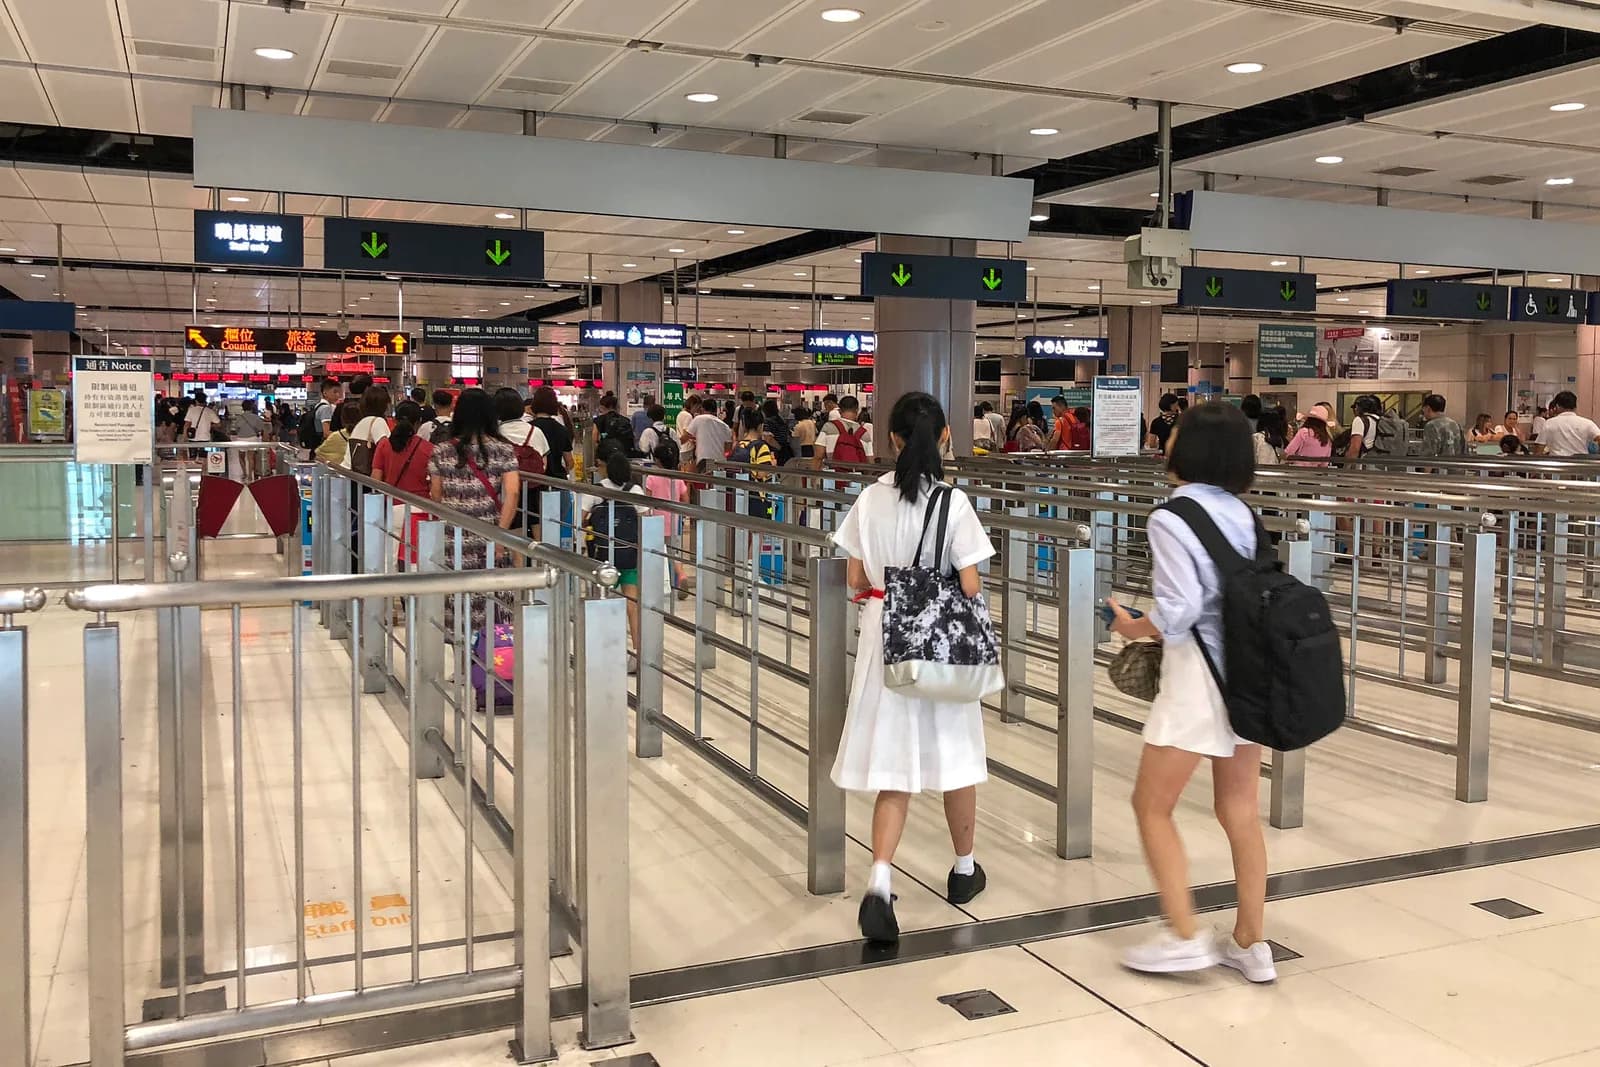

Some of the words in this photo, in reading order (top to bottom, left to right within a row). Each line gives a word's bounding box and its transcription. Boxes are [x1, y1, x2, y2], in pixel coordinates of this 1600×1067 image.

[286, 330, 317, 344] 旅客
[354, 332, 380, 346] e-道
[221, 341, 256, 351] Counter
[286, 343, 317, 352] Visitor
[345, 345, 388, 354] e-Channel
[86, 360, 109, 371] 通告
[111, 361, 143, 371] Notice
